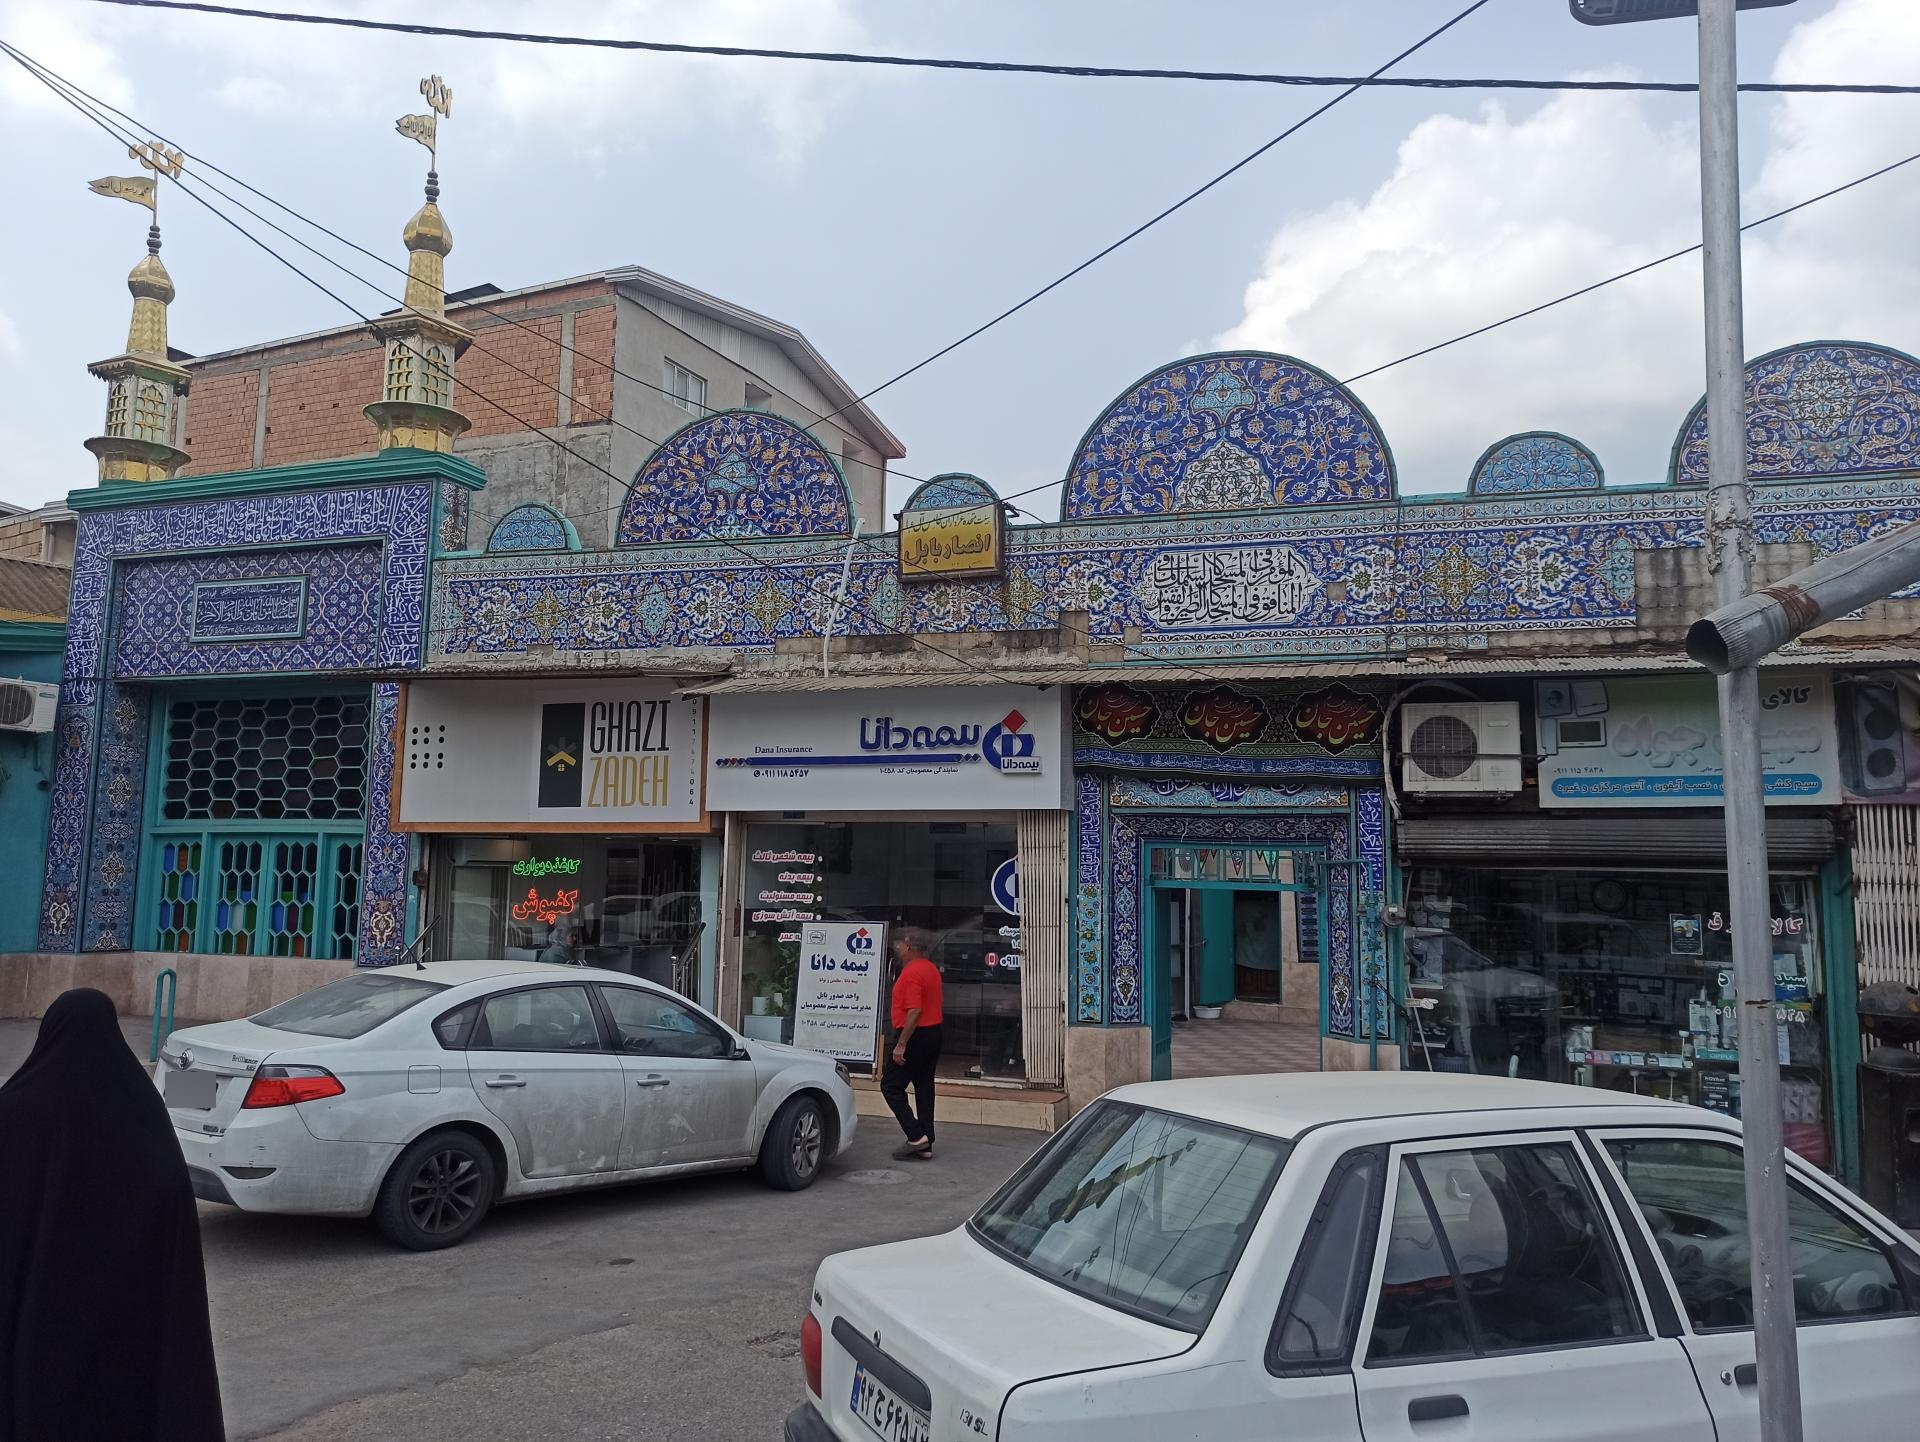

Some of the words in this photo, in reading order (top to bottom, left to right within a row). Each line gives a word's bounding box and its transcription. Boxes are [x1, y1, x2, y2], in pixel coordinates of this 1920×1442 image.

[904, 537, 943, 566] بابل
[943, 533, 991, 559] انصار
[1762, 686, 1811, 710] کالای
[590, 700, 671, 754] GHAZI
[860, 716, 912, 750] دانا
[776, 746, 813, 754] Insurance
[587, 755, 670, 807] ZADEH
[1558, 782, 1580, 792] غیره
[1590, 781, 1621, 793] مرکزی
[1622, 780, 1645, 793] آنتن
[1653, 778, 1683, 792] آیفون
[1685, 780, 1712, 792] نصب
[1765, 778, 1792, 791] کشی
[1793, 780, 1818, 791] سیم
[752, 850, 773, 862] ثالث
[772, 850, 797, 863] شخص
[796, 852, 815, 864] بیمه
[778, 872, 796, 884] بدنه
[796, 872, 814, 884] بیمه
[796, 892, 814, 904] بیمه
[513, 889, 578, 925] کفپوش
[752, 910, 777, 922] سوزی
[776, 908, 797, 922] آتش
[778, 932, 794, 942] عمر
[810, 953, 836, 971] دانا
[840, 958, 869, 976] بیمه
